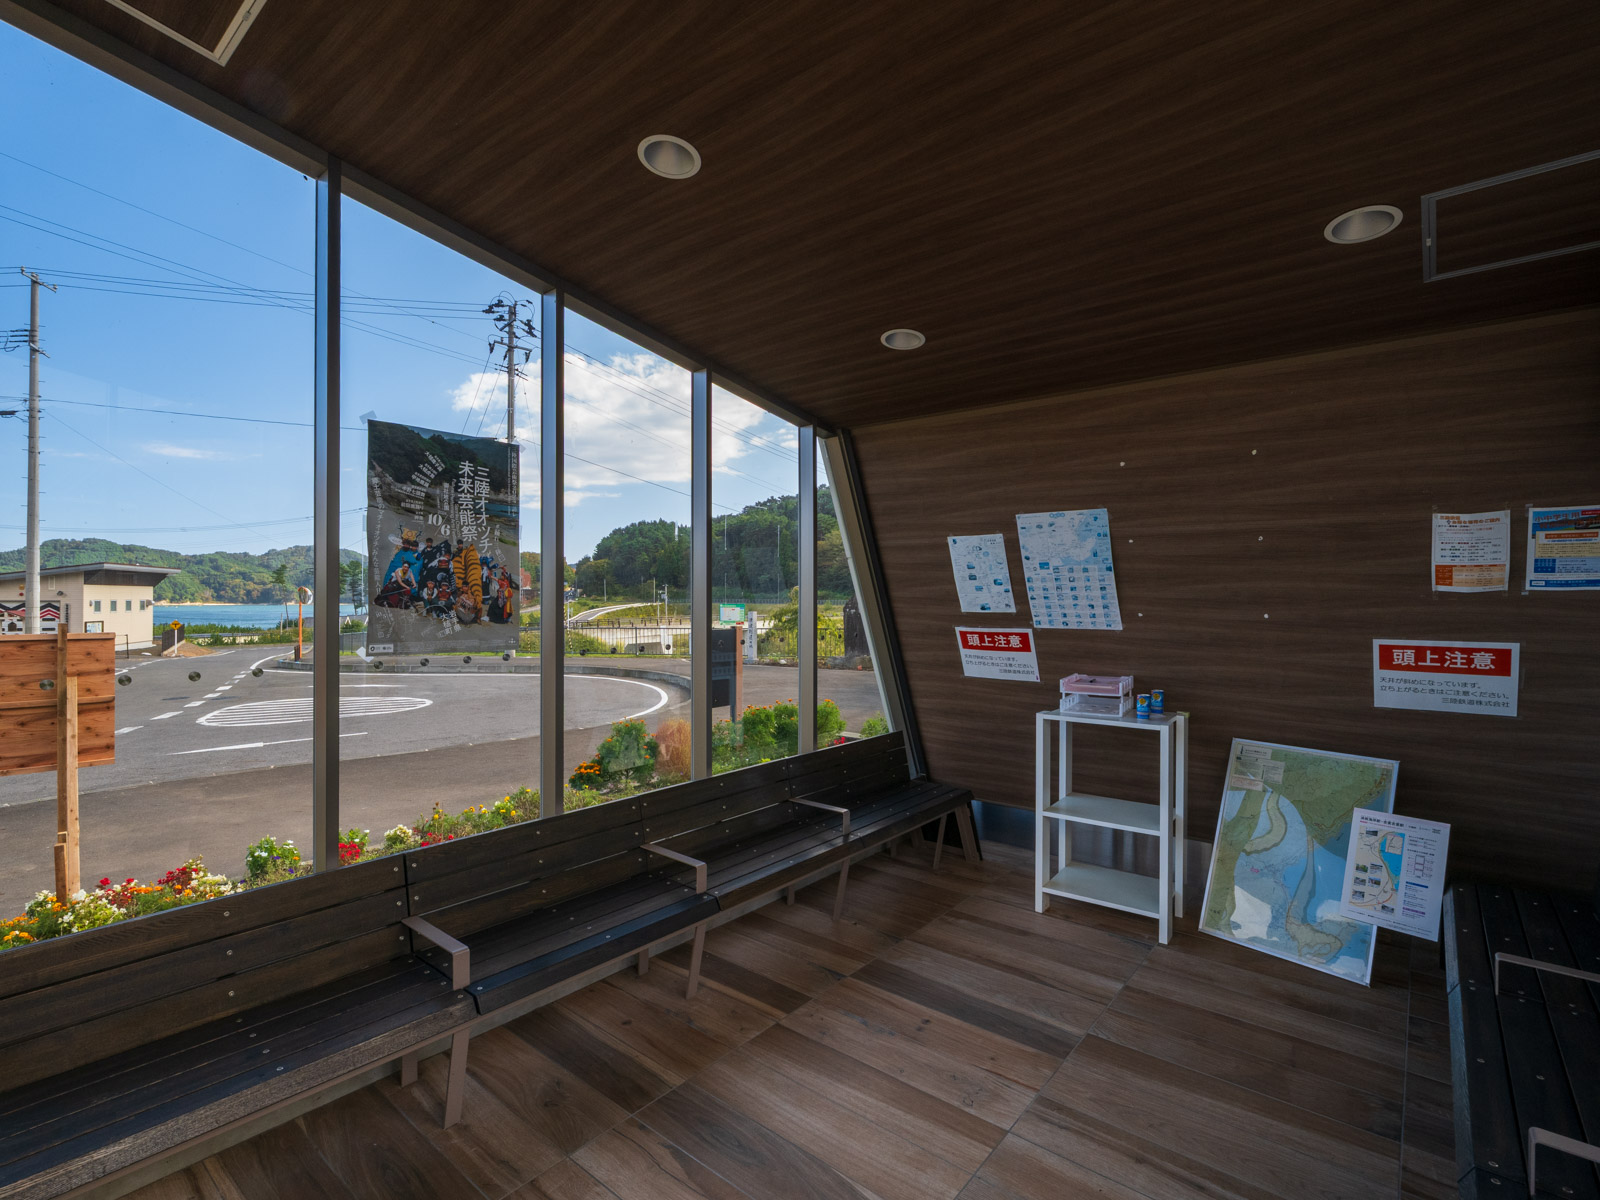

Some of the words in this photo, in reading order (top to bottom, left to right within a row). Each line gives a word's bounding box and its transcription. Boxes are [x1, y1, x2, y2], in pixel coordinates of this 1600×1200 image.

[458, 460, 477, 542] 未来芸能祭
[474, 466, 493, 553] 三陸オオツチ
[966, 633, 1023, 648] 頭上注意
[1392, 649, 1496, 670] 頭上注意
[1380, 676, 1482, 690] 天井が斜めになっています。
[1380, 685, 1510, 700] 立ち上がるときはご注意ください。
[1441, 697, 1510, 709] 三陸鉄道株式会社
